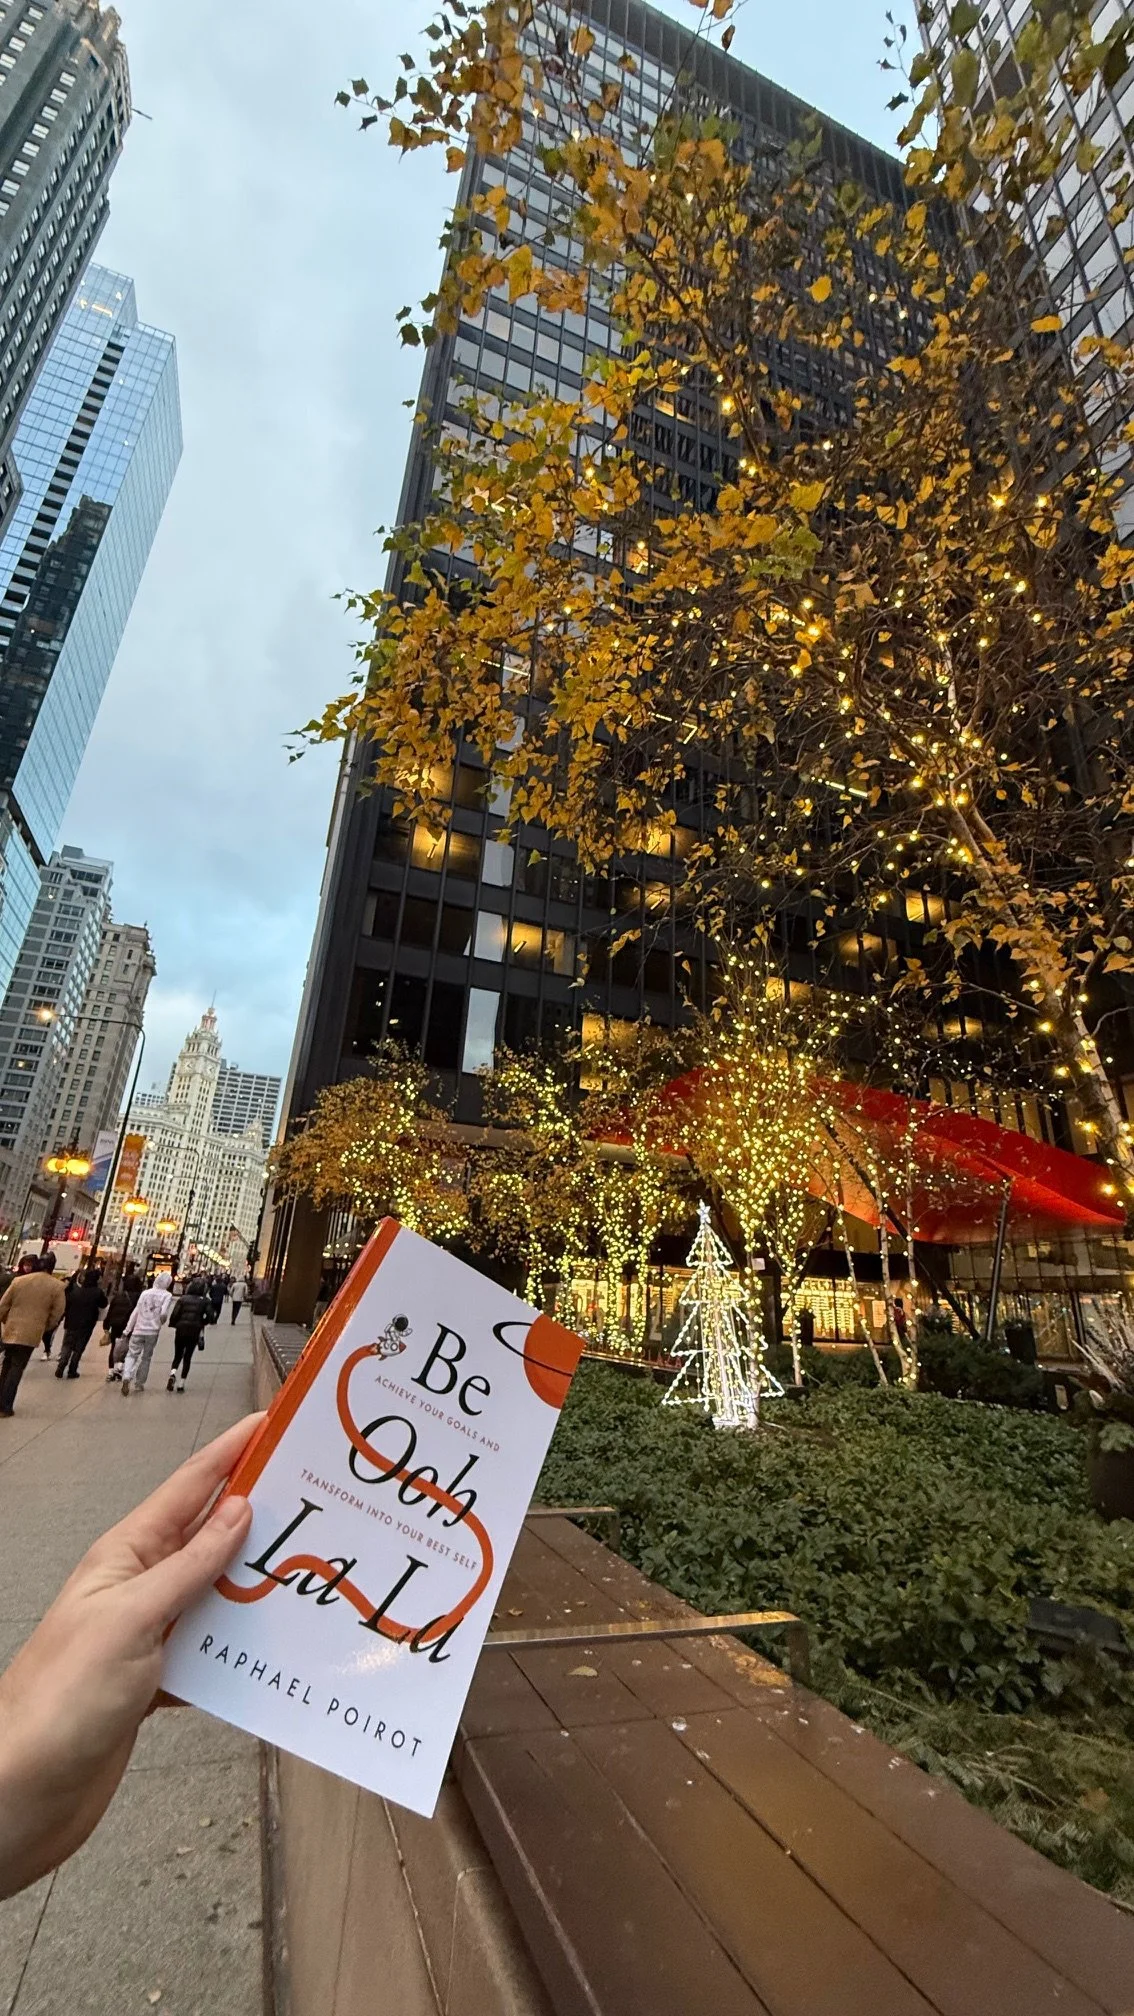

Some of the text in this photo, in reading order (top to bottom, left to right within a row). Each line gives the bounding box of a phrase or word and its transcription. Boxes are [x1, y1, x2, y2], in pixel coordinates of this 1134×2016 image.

[375, 1375, 500, 1452] ACHIEVE YOUR GOALS AND
[411, 1322, 491, 1416] Be
[300, 1468, 477, 1571] TRANSFORM INTO YOUR BEST SELF
[348, 1415, 480, 1527] Ooh
[244, 1497, 465, 1664] La La
[200, 1634, 422, 1757] RAPHAEL POIROT
